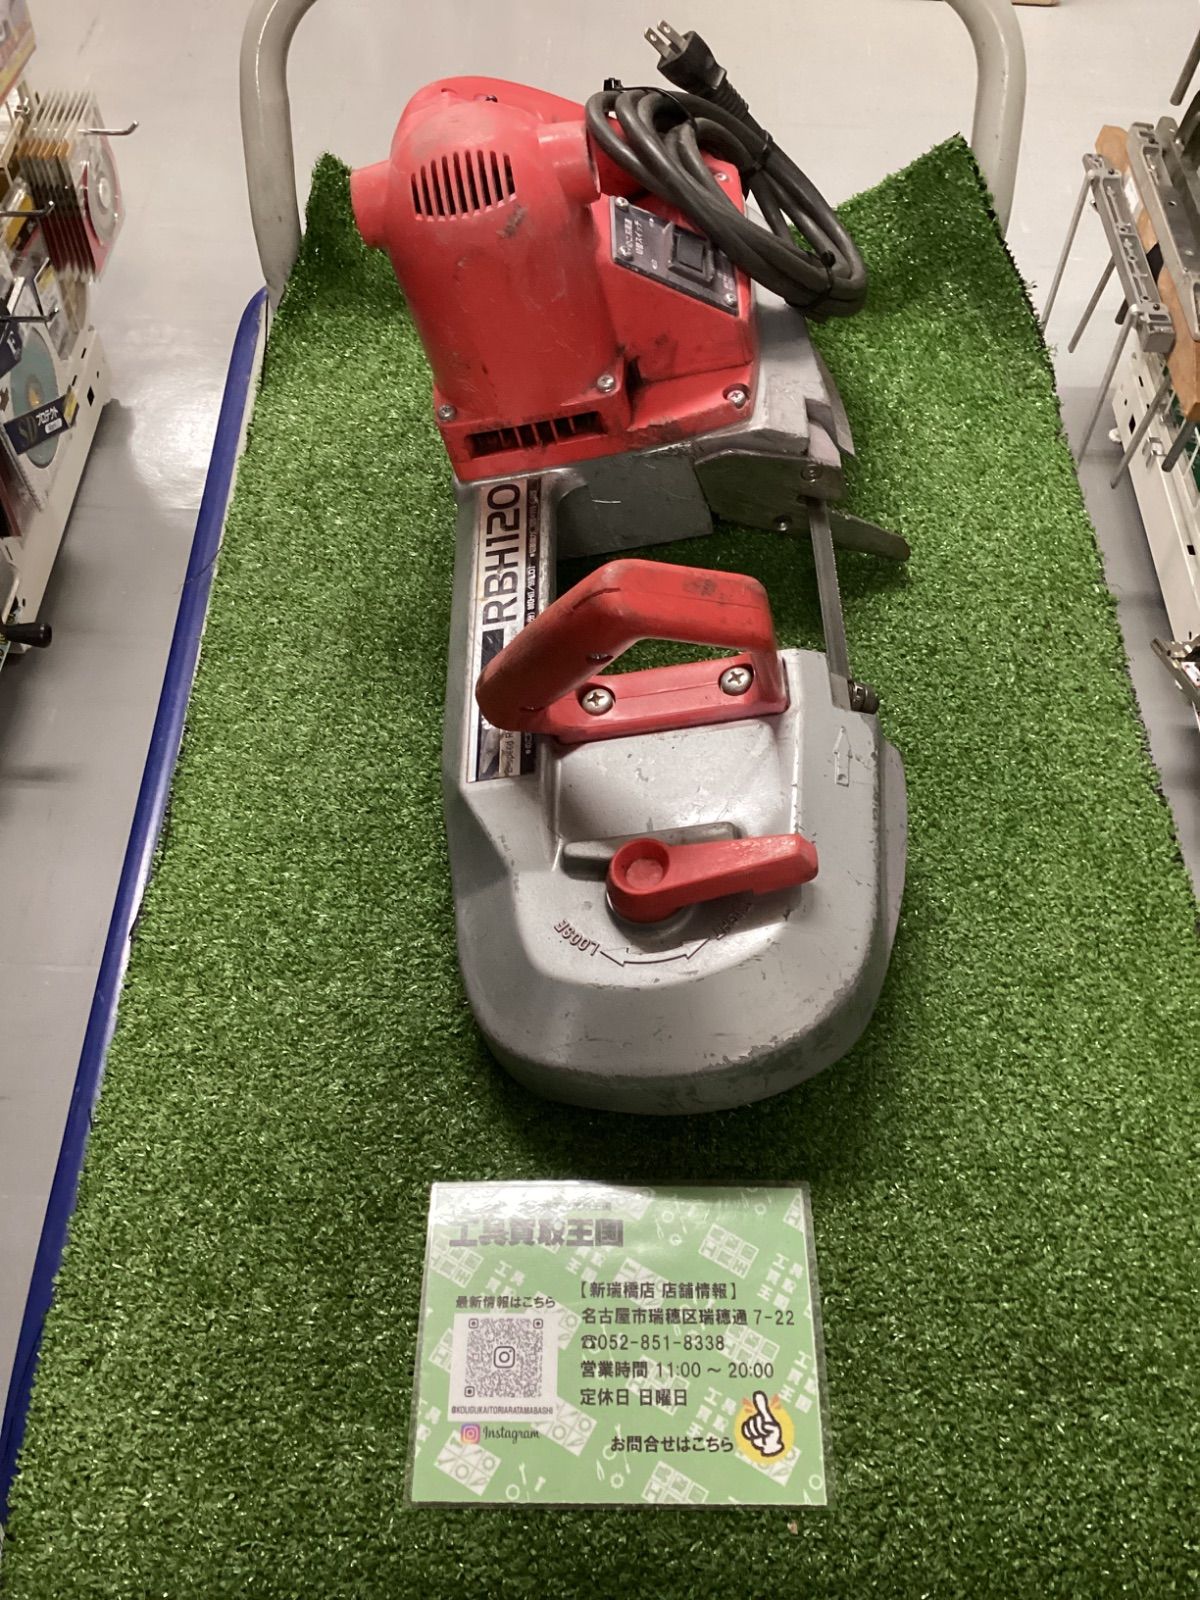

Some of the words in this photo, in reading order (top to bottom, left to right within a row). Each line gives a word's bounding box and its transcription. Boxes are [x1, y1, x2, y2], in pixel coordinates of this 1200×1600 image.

[482, 482, 521, 626] RBH120
[553, 919, 601, 957] LOOSE
[456, 1296, 556, 1309] 最新情報はこちら
[582, 1307, 748, 1326] 名古屋市瑞穂区瑞穂通
[753, 1309, 795, 1326] 7-22
[580, 1360, 648, 1379] 営業時間
[656, 1361, 701, 1378] 11:00
[728, 1361, 774, 1378] 20:00
[580, 1389, 629, 1406] 定休日
[639, 1389, 688, 1407] 日曜日
[482, 1426, 540, 1445] Instagram
[610, 1435, 734, 1453] お問合せはこちら
